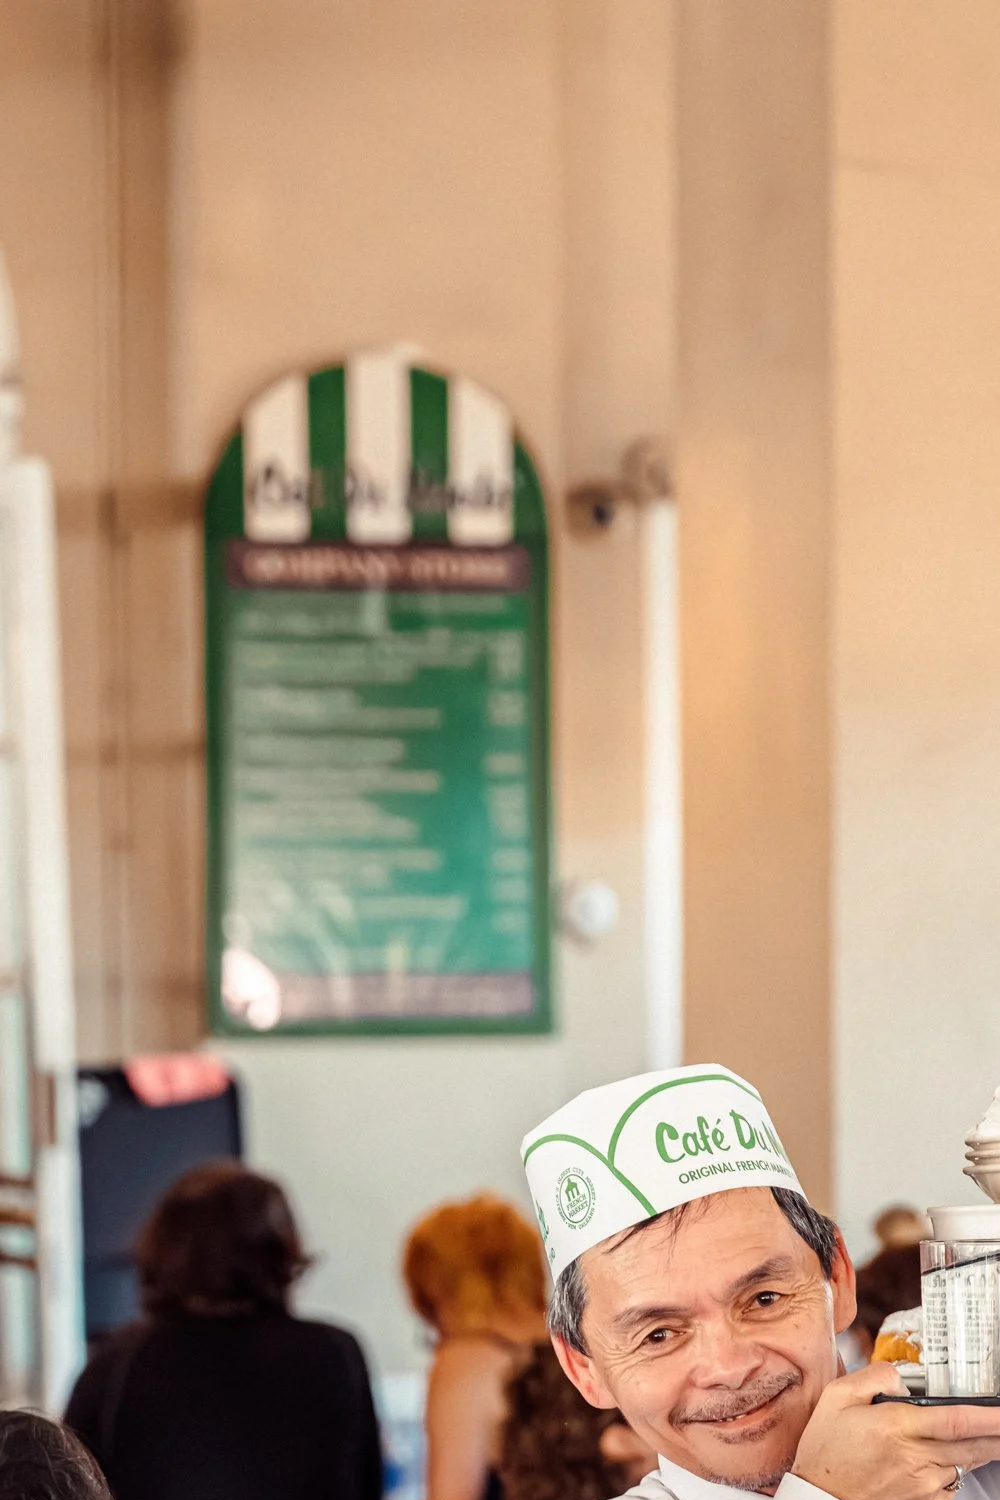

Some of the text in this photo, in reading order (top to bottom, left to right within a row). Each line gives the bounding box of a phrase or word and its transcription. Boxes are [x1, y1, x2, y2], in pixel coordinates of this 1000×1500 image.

[655, 1115, 731, 1163] Café
[729, 1109, 772, 1153] Du
[572, 1167, 584, 1176] CITY
[678, 1162, 735, 1184] ORIGINAL
[736, 1160, 770, 1172] FRENCH
[566, 1193, 587, 1211] FRENCH
[568, 1200, 589, 1218] MARKET
